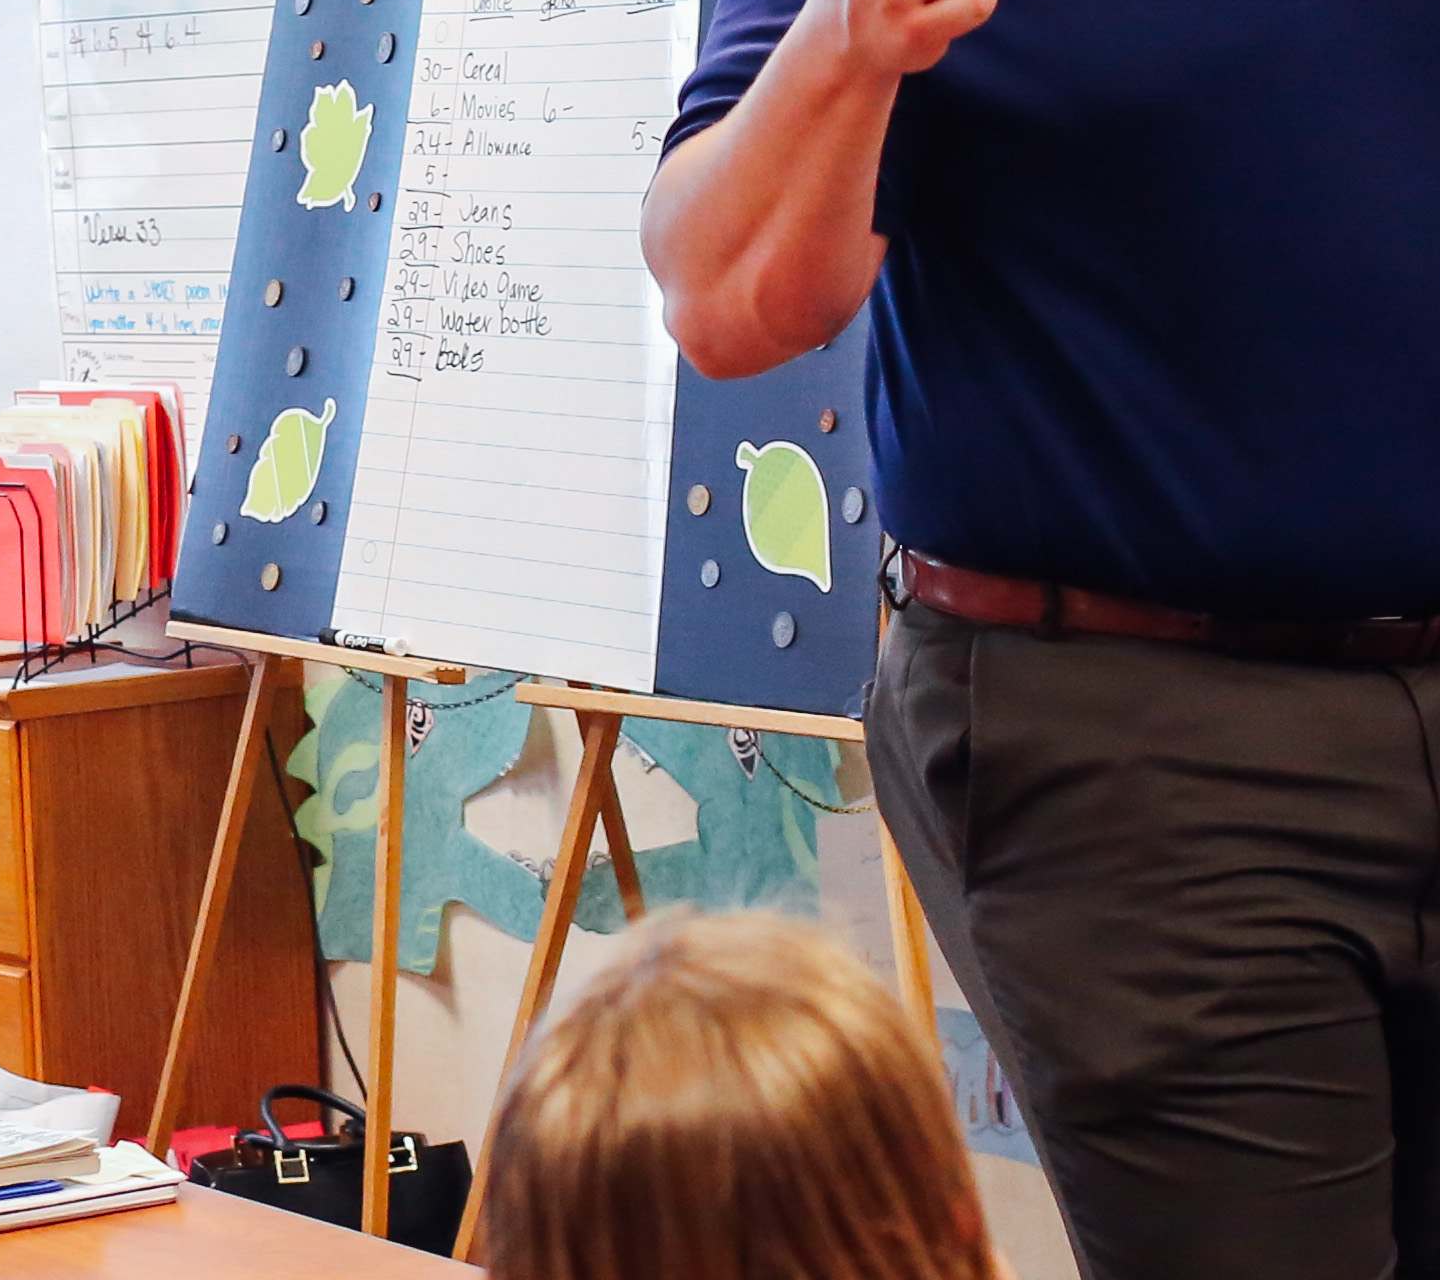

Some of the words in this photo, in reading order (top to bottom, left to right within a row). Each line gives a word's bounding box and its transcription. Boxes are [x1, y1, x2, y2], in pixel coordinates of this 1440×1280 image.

[462, 51, 509, 85] Cereal
[461, 90, 516, 122] Movies
[462, 129, 533, 157] Allowance
[458, 193, 513, 231] Jeans
[136, 217, 162, 246] 33
[451, 229, 507, 266] Shoes
[442, 270, 489, 303] Video
[440, 305, 491, 336] Water
[499, 306, 552, 337] bottle
[435, 335, 485, 372] Books
